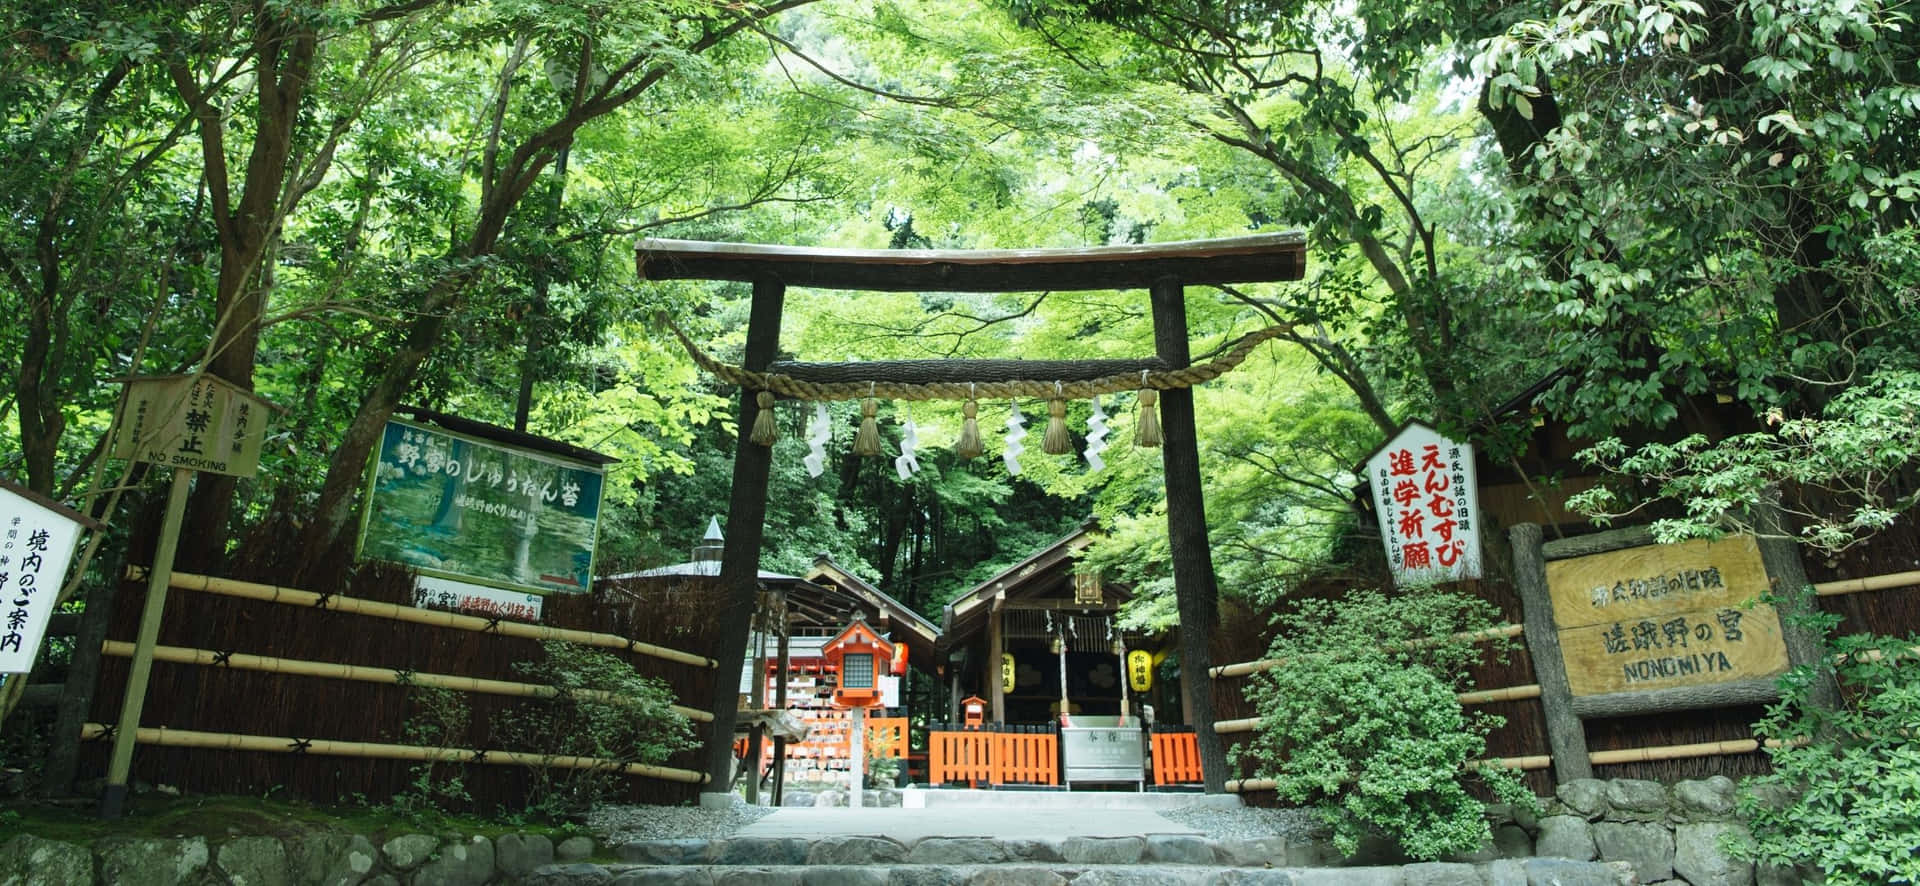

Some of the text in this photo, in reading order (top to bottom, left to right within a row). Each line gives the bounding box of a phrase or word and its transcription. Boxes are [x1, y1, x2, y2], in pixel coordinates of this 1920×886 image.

[178, 408, 212, 455] 禁止
[149, 451, 227, 472] NO SMOKING
[399, 442, 581, 507] 野宮のじゅうたん苔
[1389, 448, 1432, 571] 進学祈願
[1421, 444, 1466, 568] えんむすび
[0, 528, 51, 653] 境内のご案内
[1602, 608, 1744, 654] 嵯峨野の宮
[1623, 650, 1733, 683] NONOMIYA
